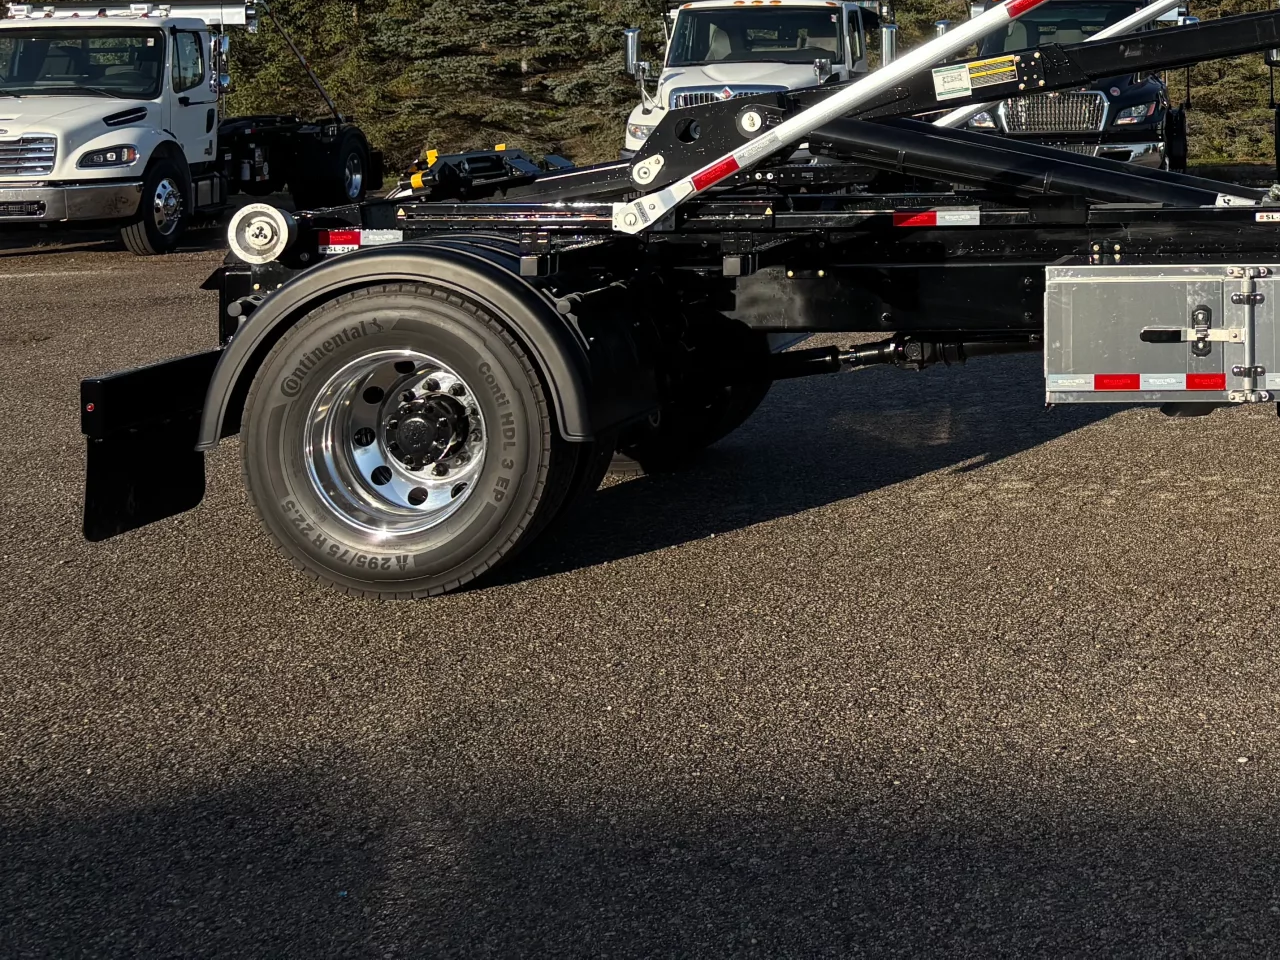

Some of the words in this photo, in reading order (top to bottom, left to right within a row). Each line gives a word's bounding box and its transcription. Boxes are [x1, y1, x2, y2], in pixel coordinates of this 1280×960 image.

[281, 320, 368, 397] Continental
[478, 362, 510, 407] Conti
[501, 412, 516, 451] HDL
[502, 458, 514, 470] 3
[493, 476, 511, 503] EP
[281, 500, 314, 537] 22.5
[313, 533, 325, 549] R
[327, 544, 391, 571] 295/75
